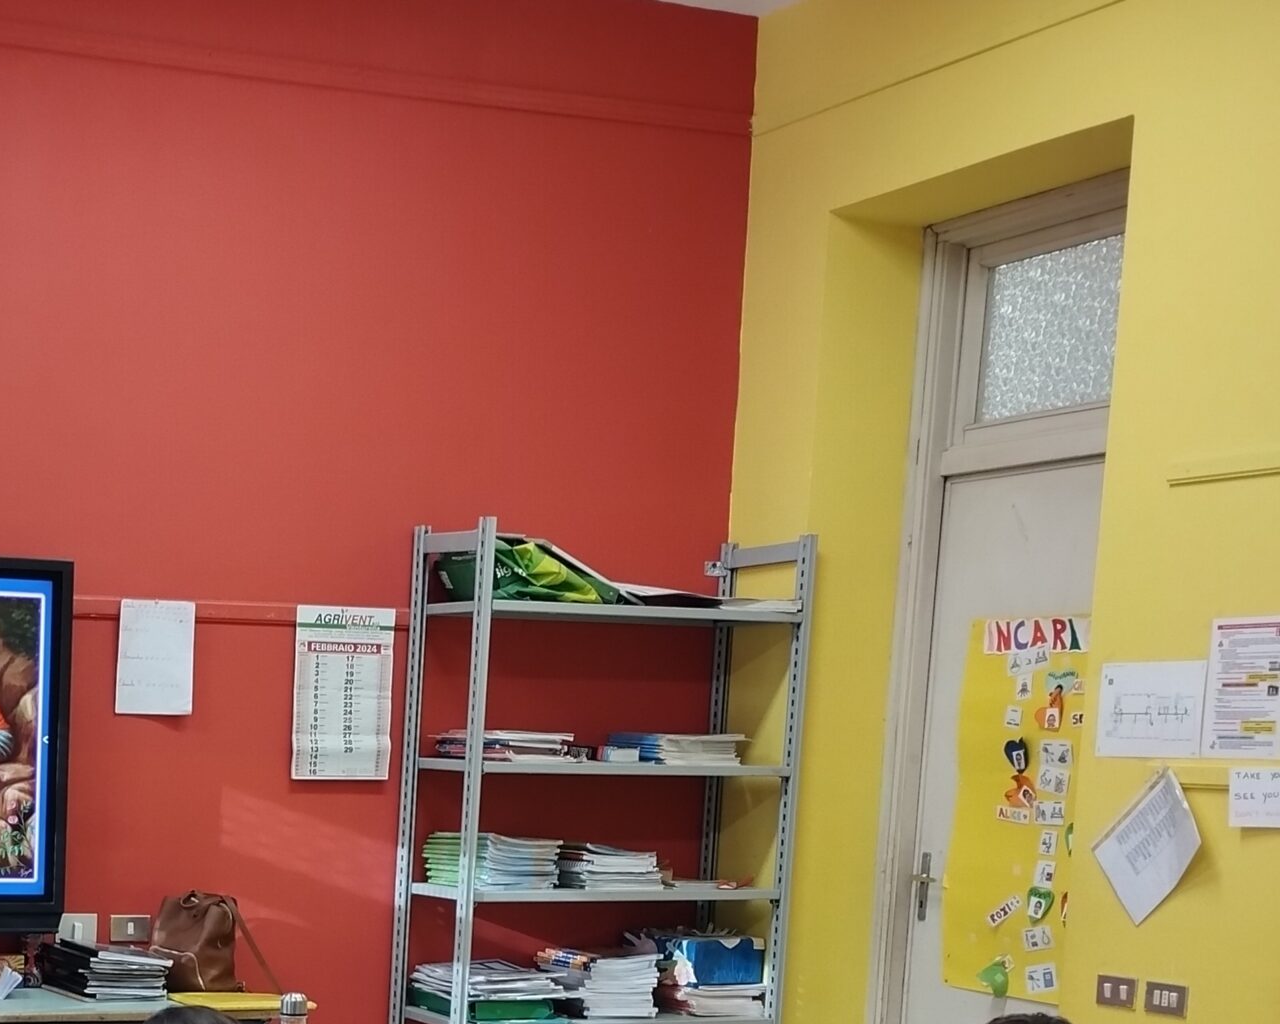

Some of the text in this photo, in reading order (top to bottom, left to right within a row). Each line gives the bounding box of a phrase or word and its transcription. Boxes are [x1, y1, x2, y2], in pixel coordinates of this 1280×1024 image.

[314, 613, 375, 626] AGRIVENT
[987, 618, 1082, 653] INCARI
[311, 642, 377, 653] FEBBRAIO 2024
[1235, 772, 1261, 780] TAKE
[1234, 792, 1256, 800] SEE
